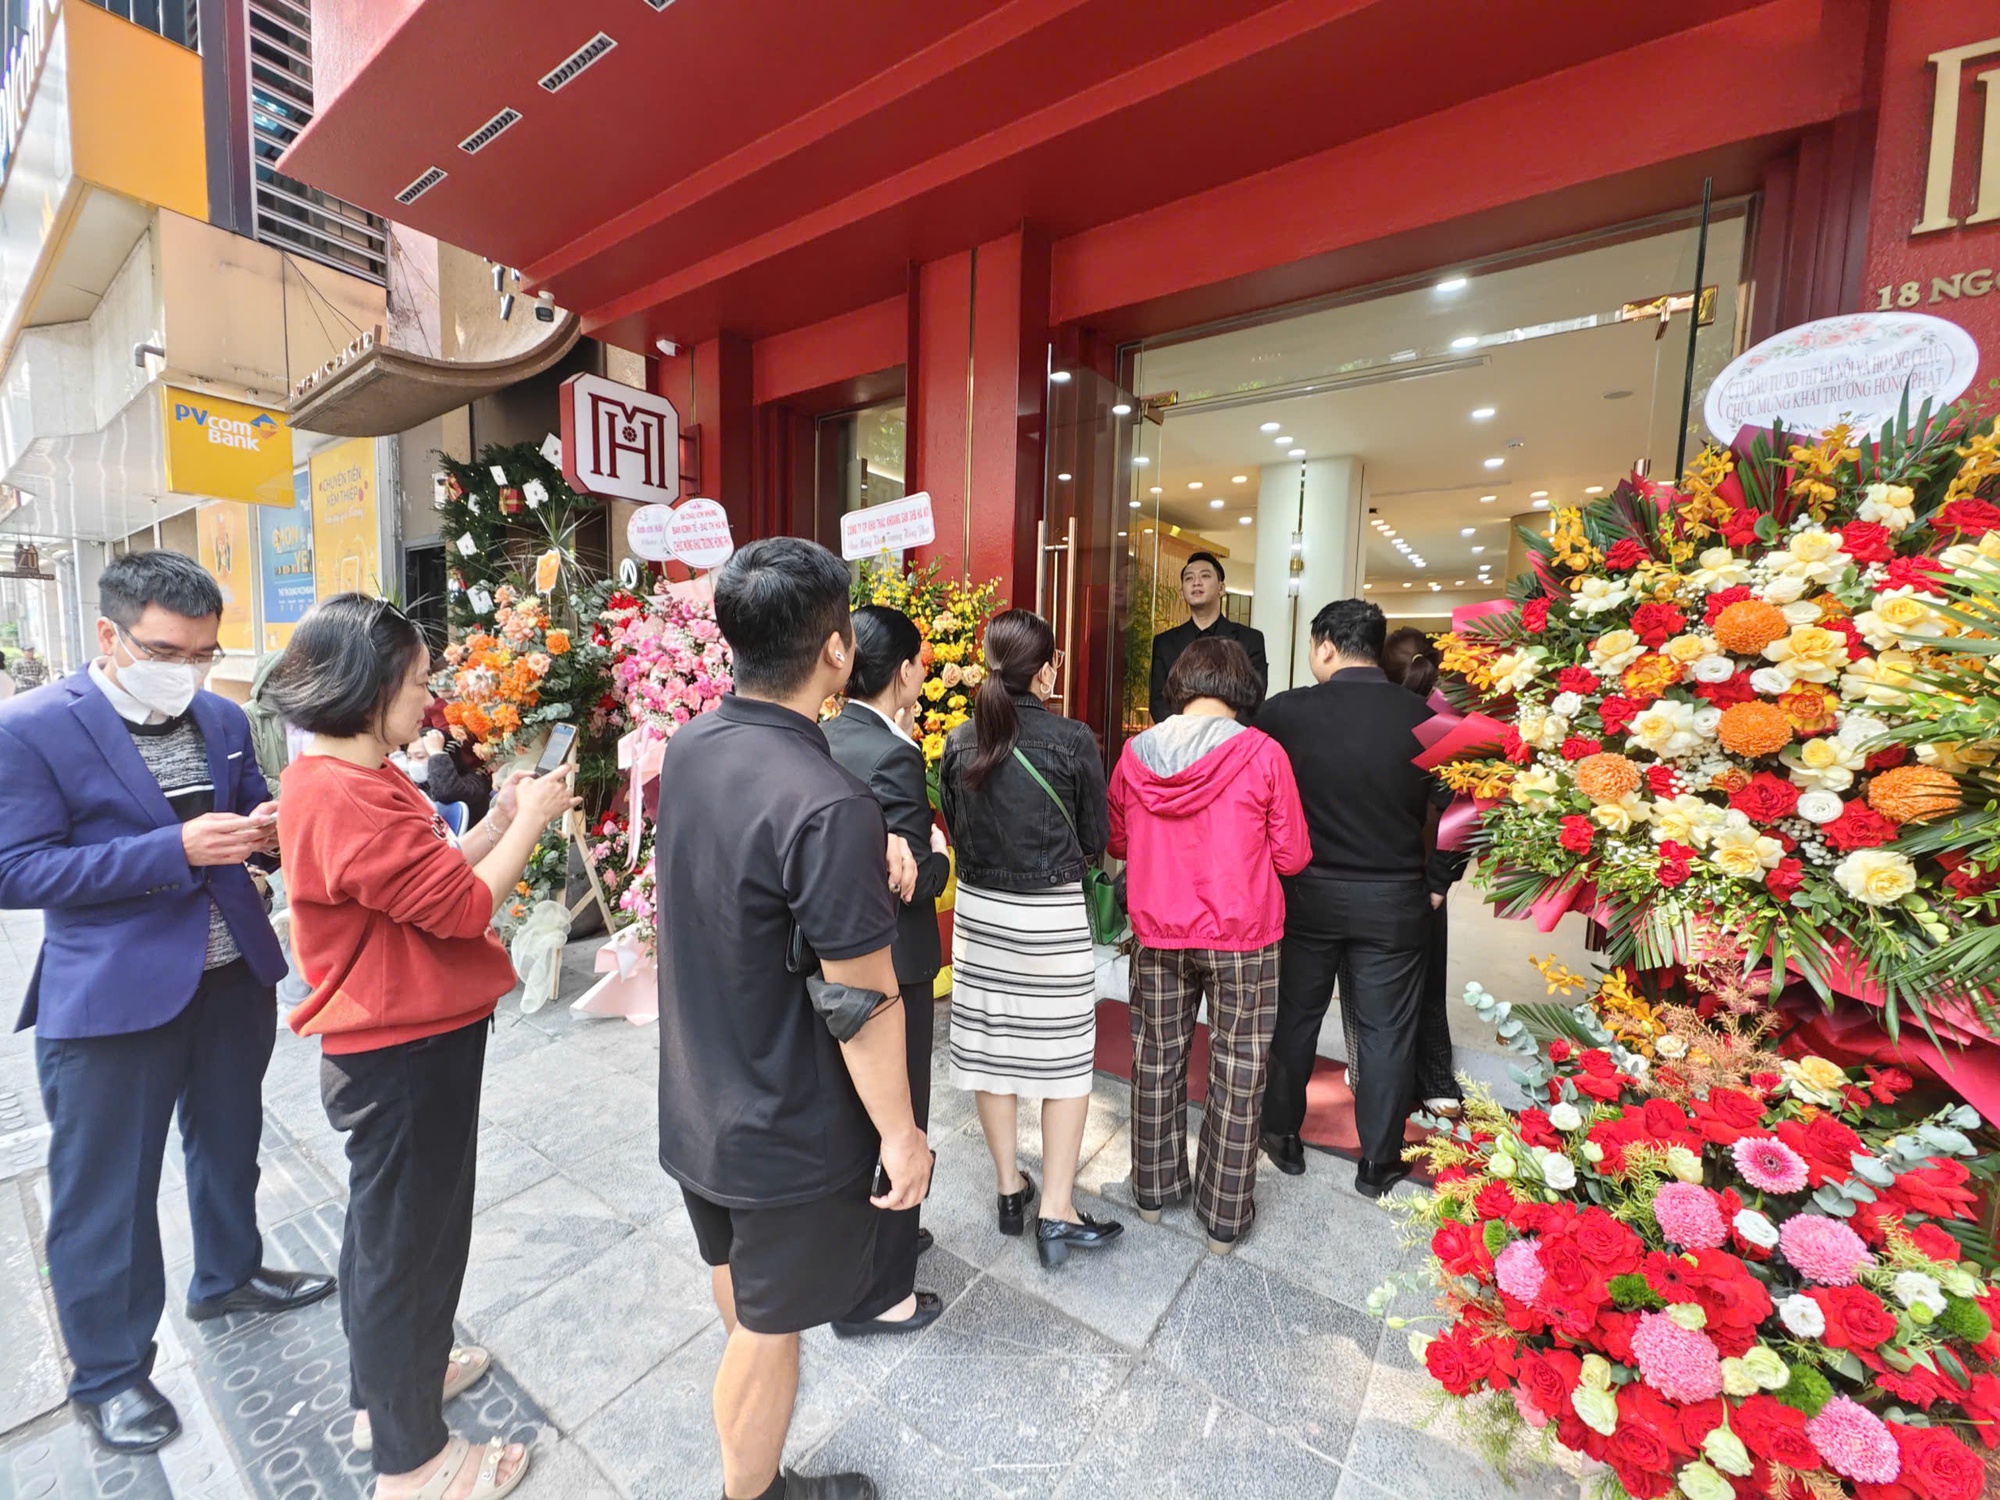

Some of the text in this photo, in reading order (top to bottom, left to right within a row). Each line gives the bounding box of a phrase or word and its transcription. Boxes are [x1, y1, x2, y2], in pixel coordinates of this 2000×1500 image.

[1876, 267, 2000, 311] 18 NG
[1792, 388, 1822, 410] KHAI
[175, 403, 252, 436] PVcom
[208, 428, 260, 452] Bank
